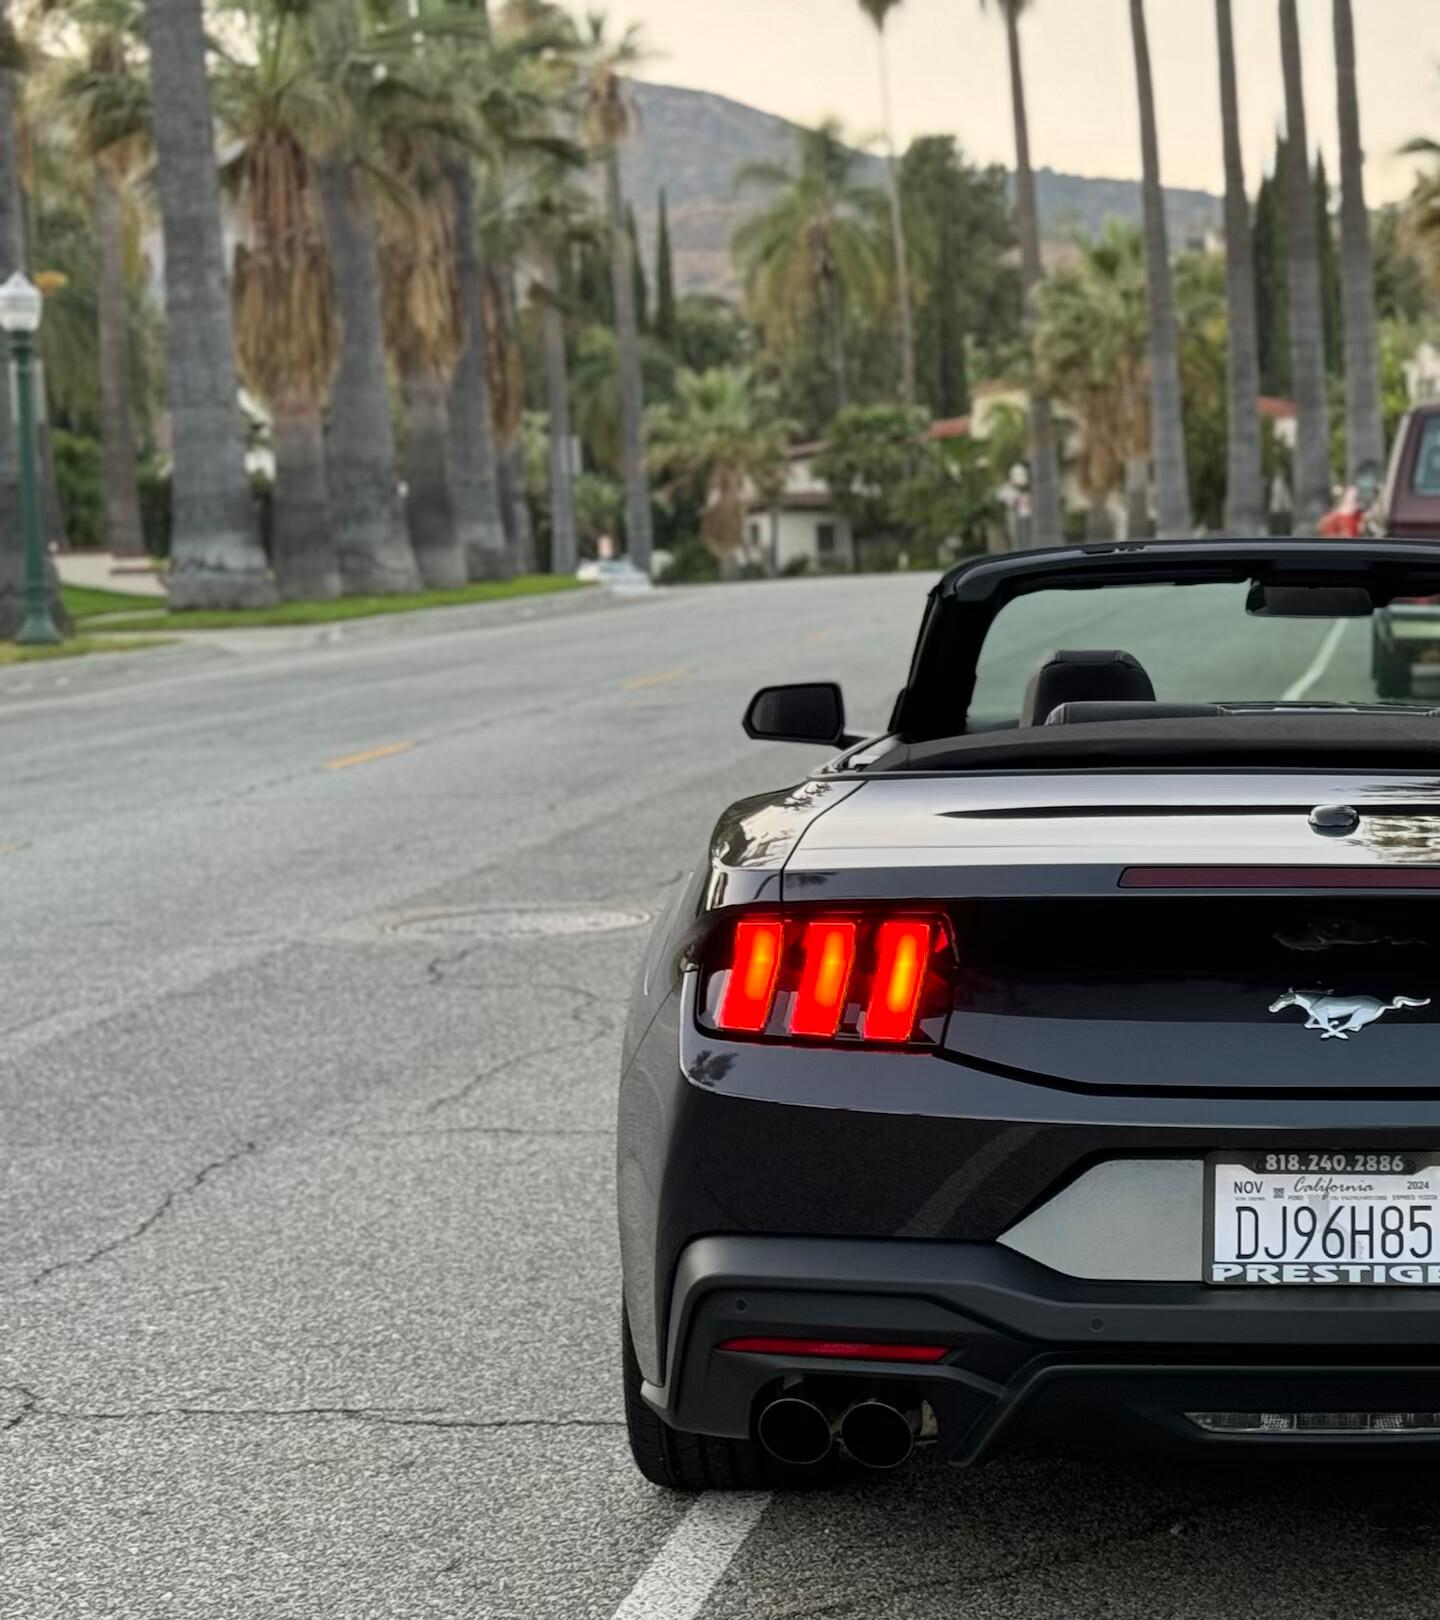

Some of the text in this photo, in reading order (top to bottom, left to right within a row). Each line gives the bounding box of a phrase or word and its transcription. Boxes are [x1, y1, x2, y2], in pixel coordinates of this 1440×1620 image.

[1266, 1154, 1404, 1171] 818.240.2886
[1233, 1181, 1264, 1194] NOV
[1293, 1176, 1374, 1200] California
[1406, 1181, 1430, 1190] 2024
[1235, 1205, 1433, 1260] DJ96H85
